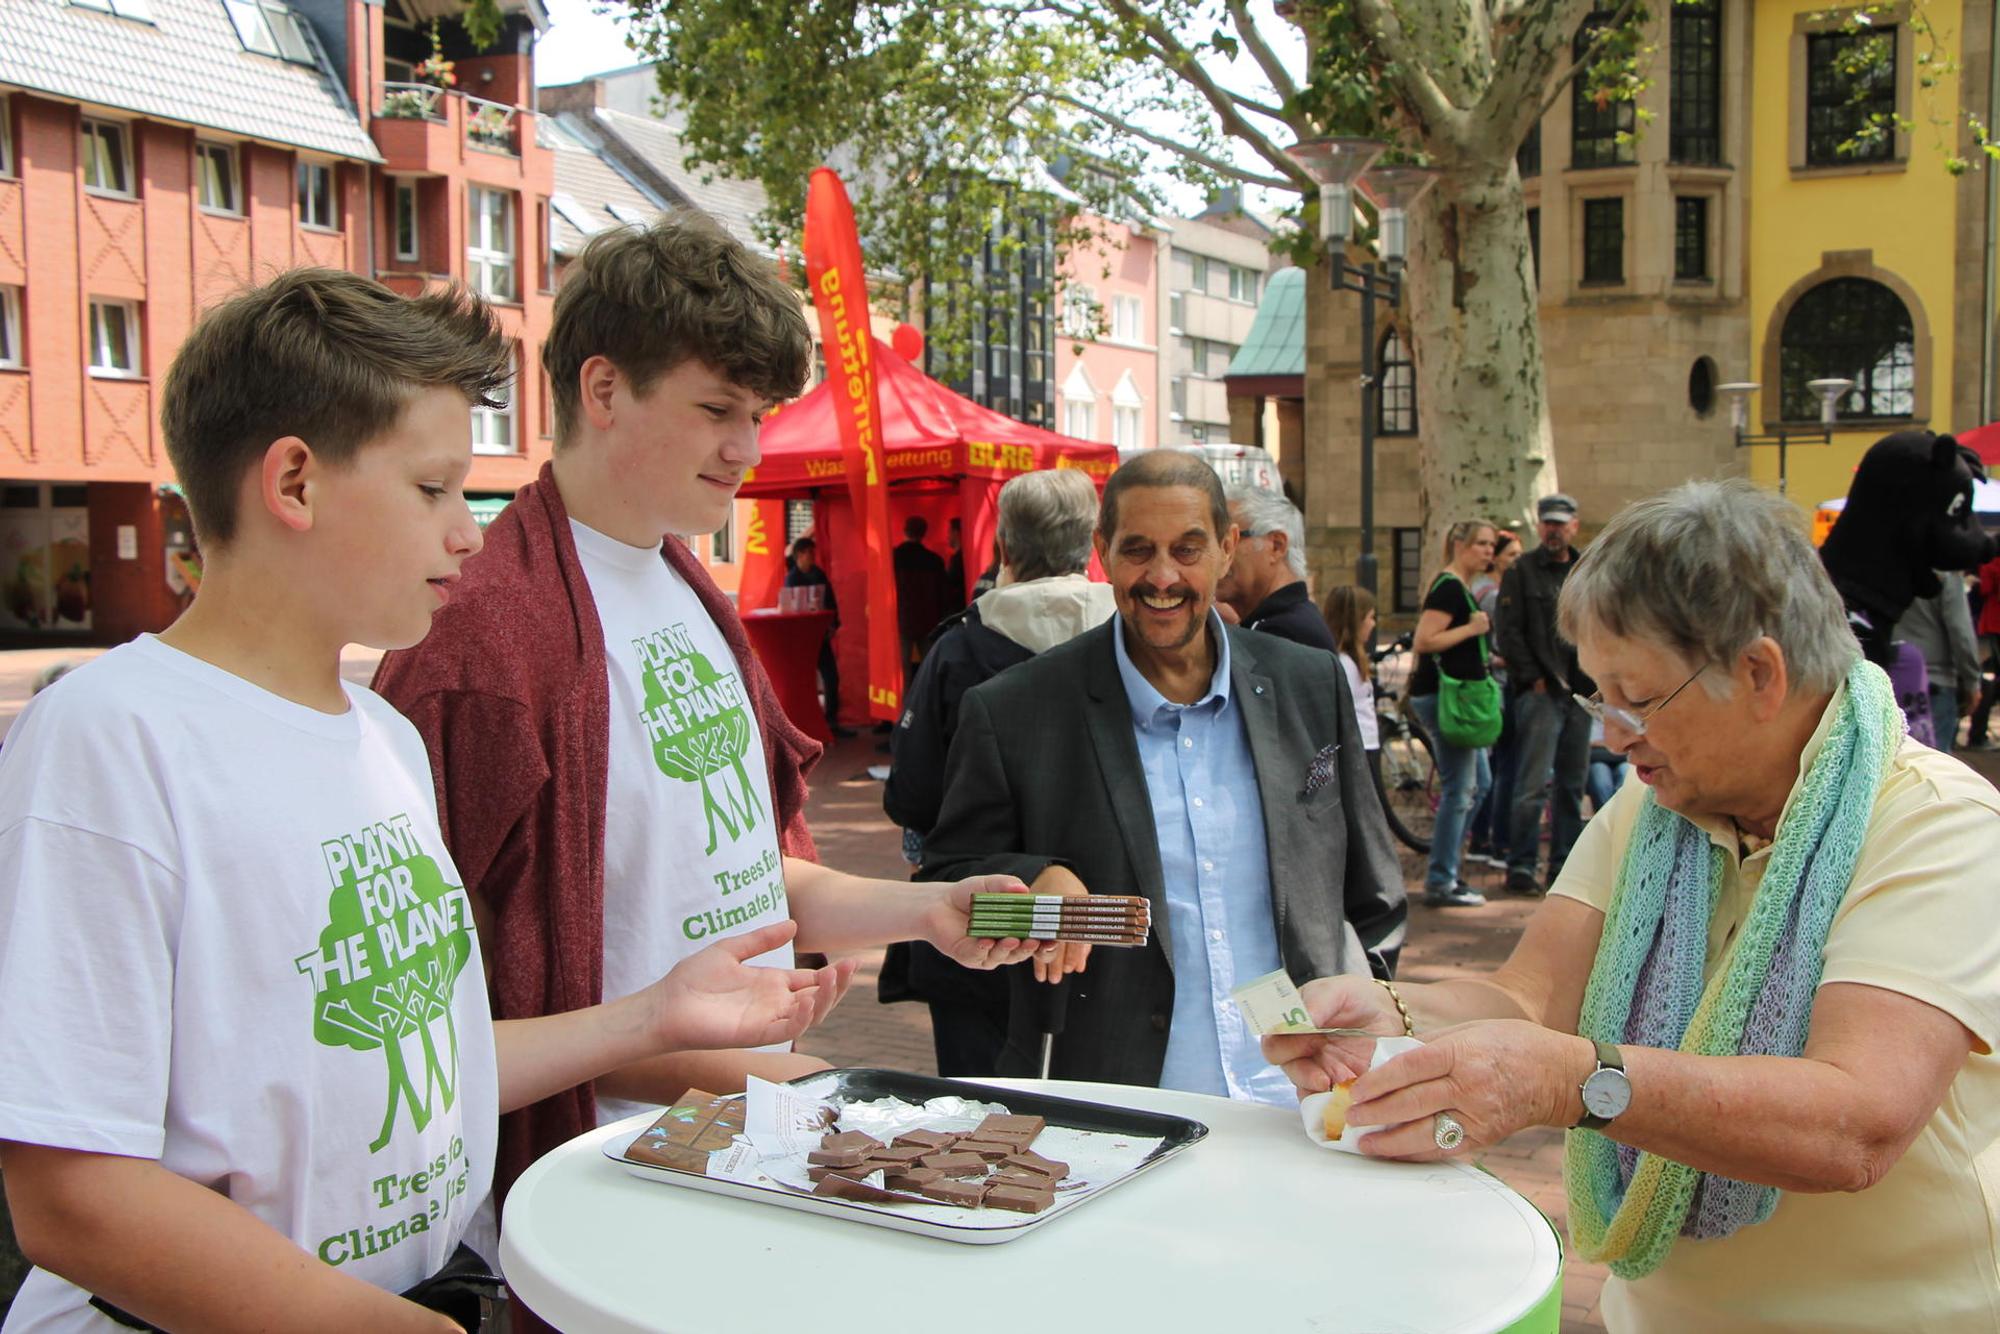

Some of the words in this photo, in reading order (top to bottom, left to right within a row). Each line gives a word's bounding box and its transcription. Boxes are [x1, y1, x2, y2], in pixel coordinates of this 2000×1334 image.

[968, 442, 1034, 470] DLRG
[632, 622, 697, 673] PLANT
[655, 658, 701, 700] FOR
[639, 703, 684, 742] THE
[675, 672, 742, 729] PLANET
[321, 813, 421, 888] PLANT
[356, 865, 421, 926] FOR
[714, 860, 765, 896] Trees
[295, 932, 372, 992] THE
[377, 886, 475, 969] PLANET
[682, 893, 770, 940] Climate
[1282, 1007, 1306, 1027] 5
[318, 1200, 439, 1266] Climae
